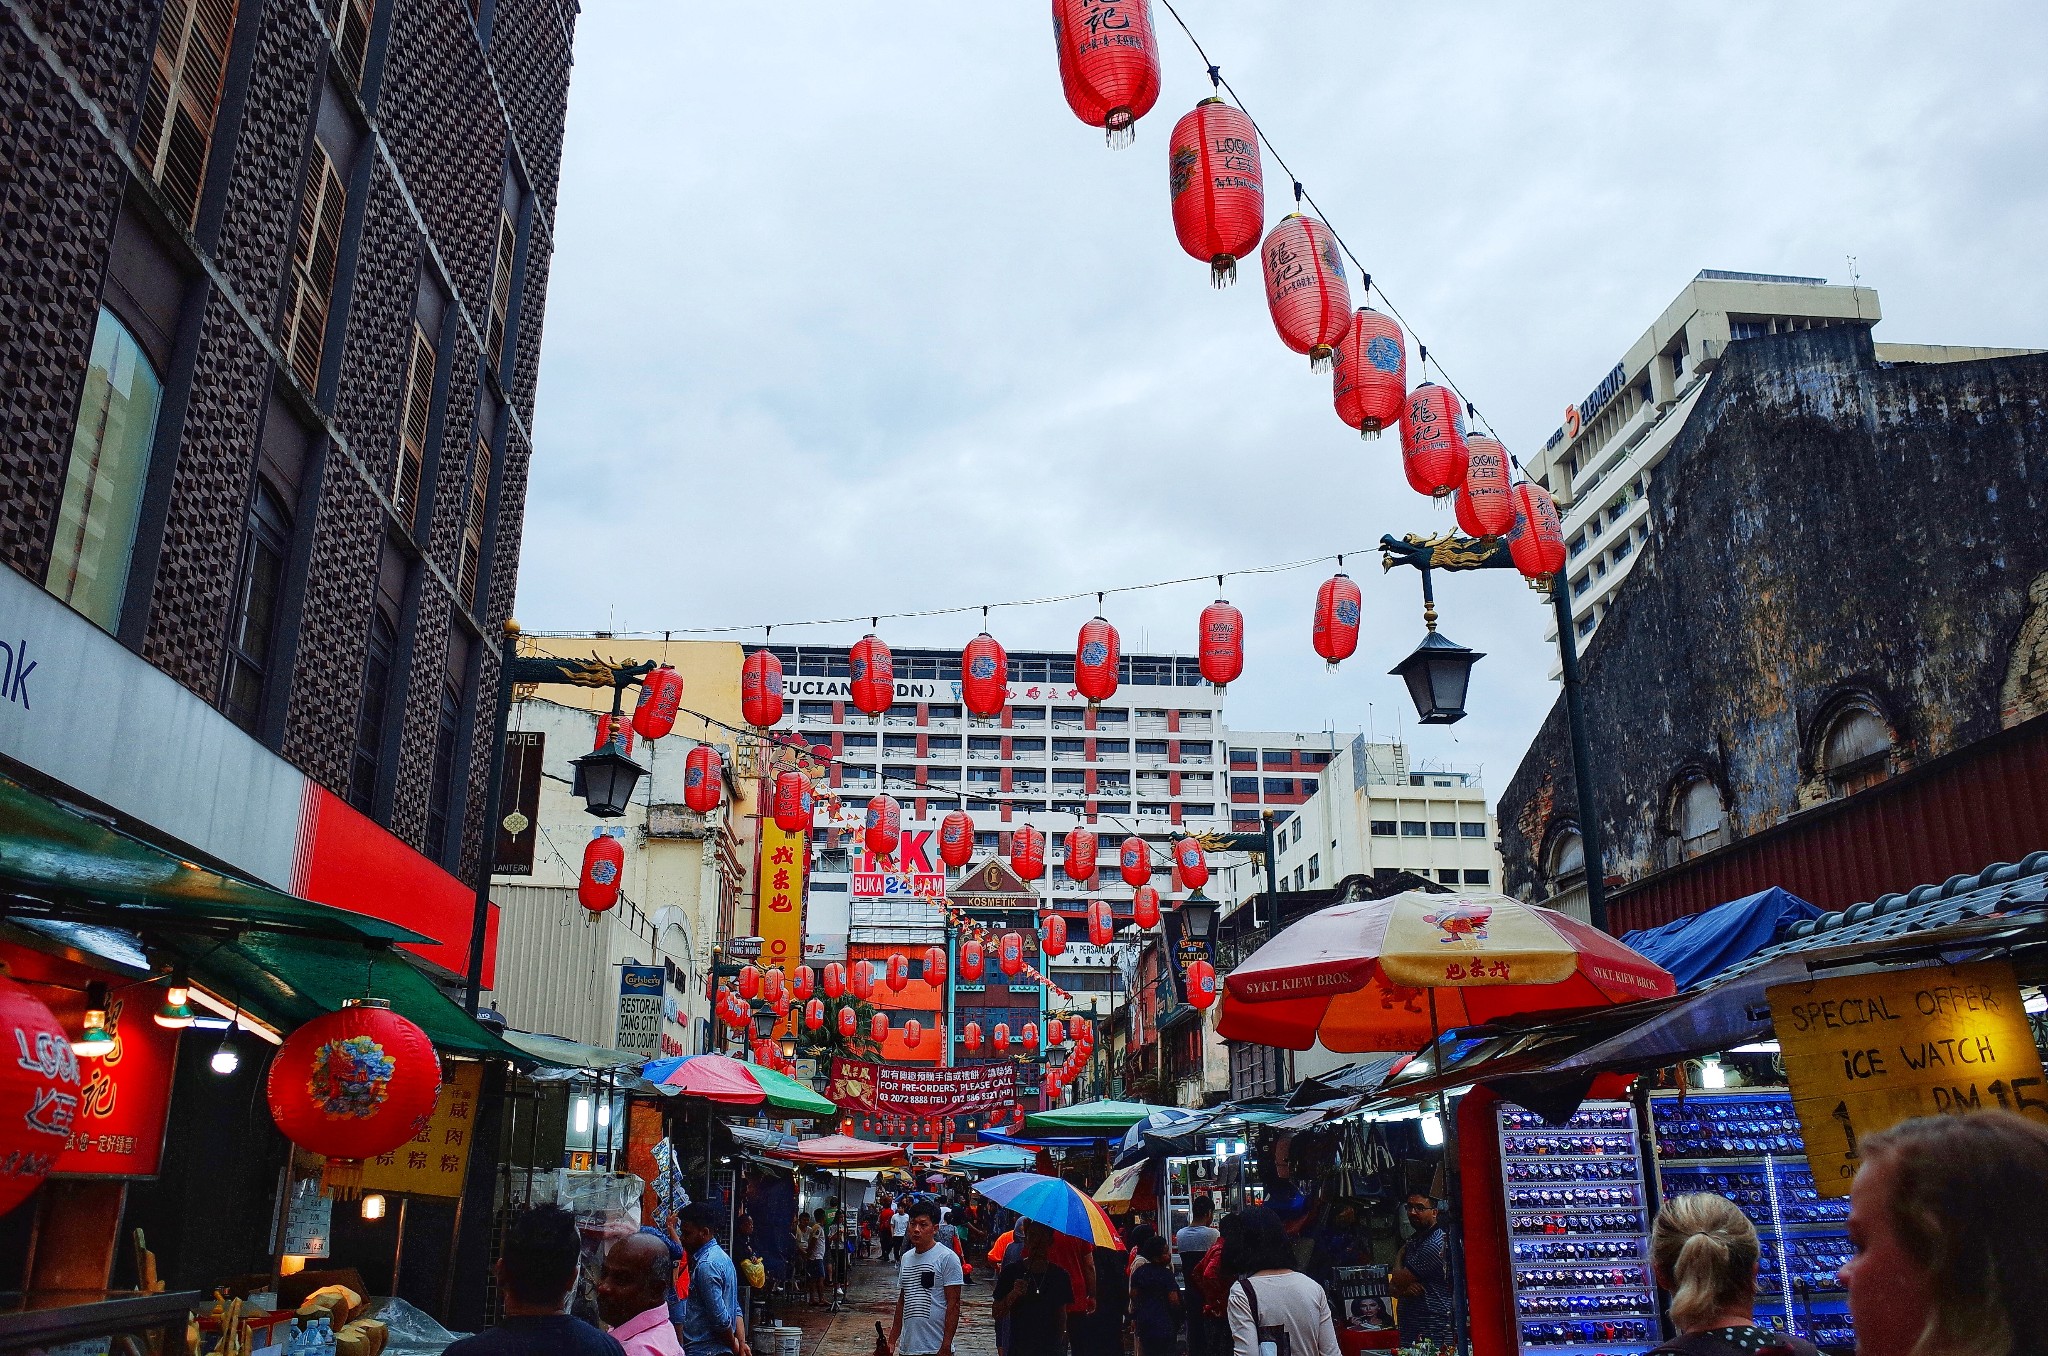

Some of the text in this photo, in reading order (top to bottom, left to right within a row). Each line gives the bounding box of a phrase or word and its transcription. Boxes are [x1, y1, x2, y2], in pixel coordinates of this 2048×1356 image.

[1566, 403, 1580, 439] 5
[1580, 361, 1626, 426] ELEMENTS
[493, 864, 530, 873] LANTERN
[854, 877, 883, 893] BUKA
[885, 876, 912, 894] 24
[968, 897, 1017, 907] KOSMETIK
[1178, 952, 1209, 961] TATTOO
[625, 973, 660, 988] Carlsberg
[1246, 972, 1352, 994] SYKT. KIEW BROS.
[1594, 966, 1659, 991] SYKT. KIEW BROS.
[621, 998, 661, 1014] RESTORAN
[1791, 984, 2001, 1032] SPECIAL OFFER
[621, 1015, 659, 1031] TANG CITY
[618, 1033, 635, 1047] FOOD
[637, 1033, 658, 1048] COURT
[1901, 1035, 1996, 1070] WATCH
[880, 1077, 1013, 1093] FOR PRE-ORDERS, PLEASE CALL
[890, 1094, 909, 1103] 2072
[910, 1095, 929, 1104] 8888
[930, 1095, 947, 1105] (TEL)
[951, 1095, 965, 1103] 012
[981, 1091, 998, 1100] 8321
[999, 1088, 1014, 1098] (HP)
